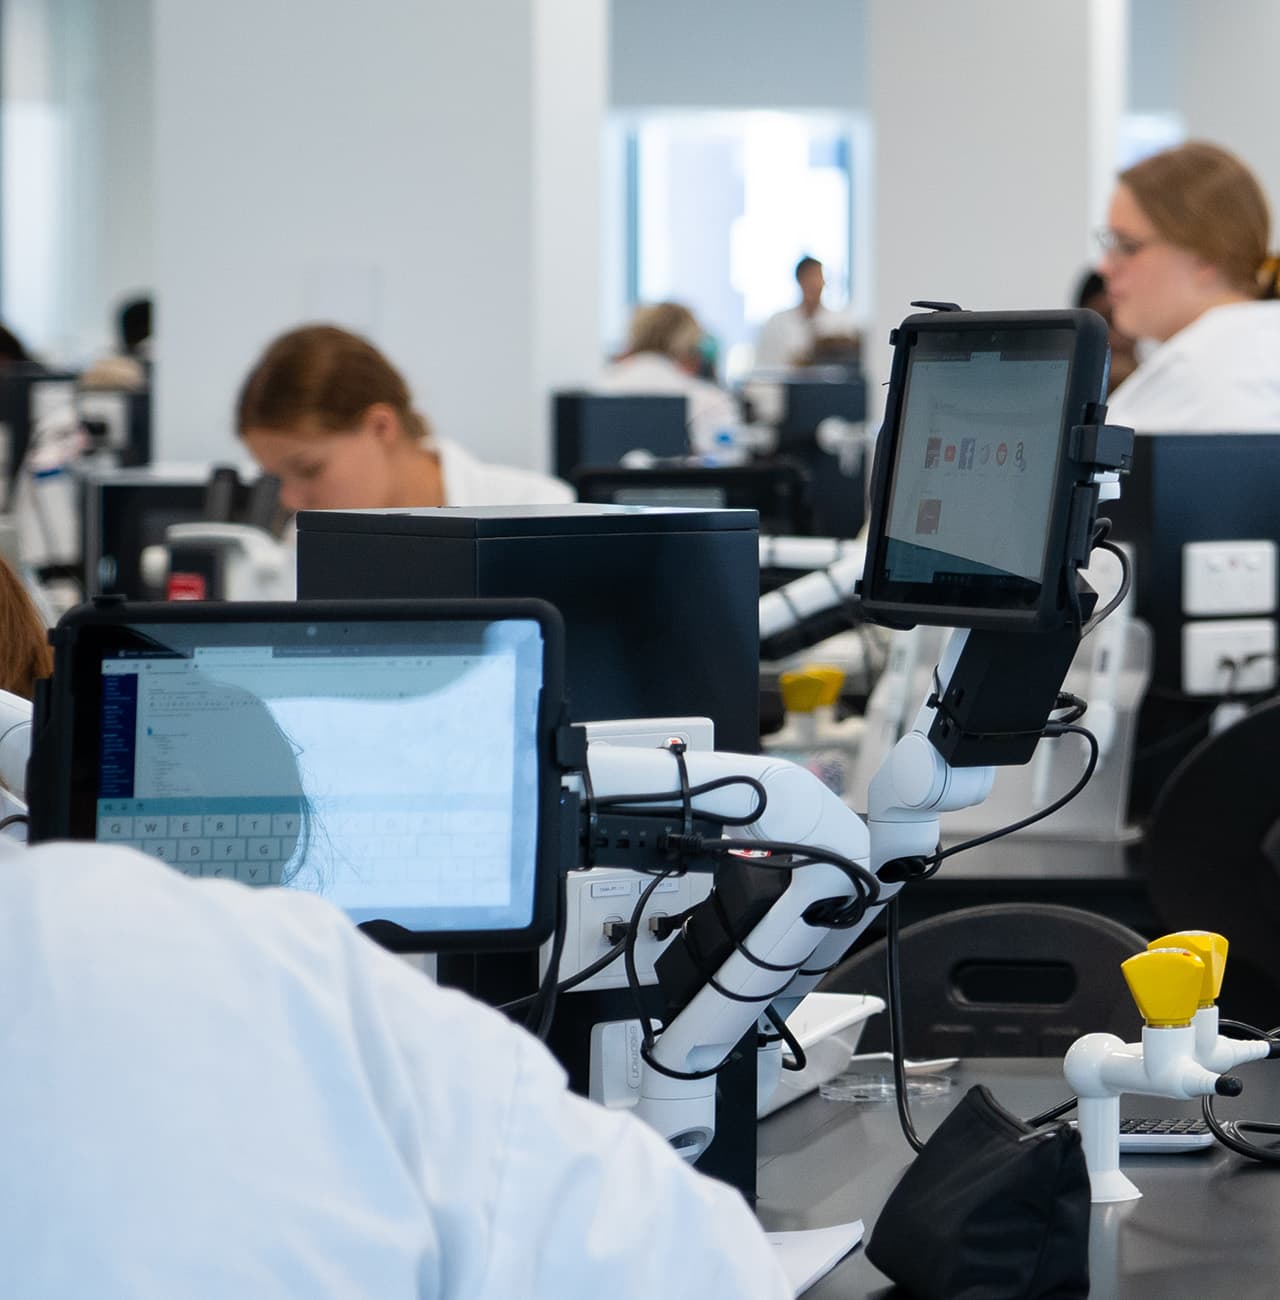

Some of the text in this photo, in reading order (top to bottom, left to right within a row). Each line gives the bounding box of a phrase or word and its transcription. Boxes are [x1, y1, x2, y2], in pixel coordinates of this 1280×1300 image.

[111, 821, 293, 833] Q W E R T Y
[157, 845, 269, 856] S D F G
[249, 868, 257, 878] V
